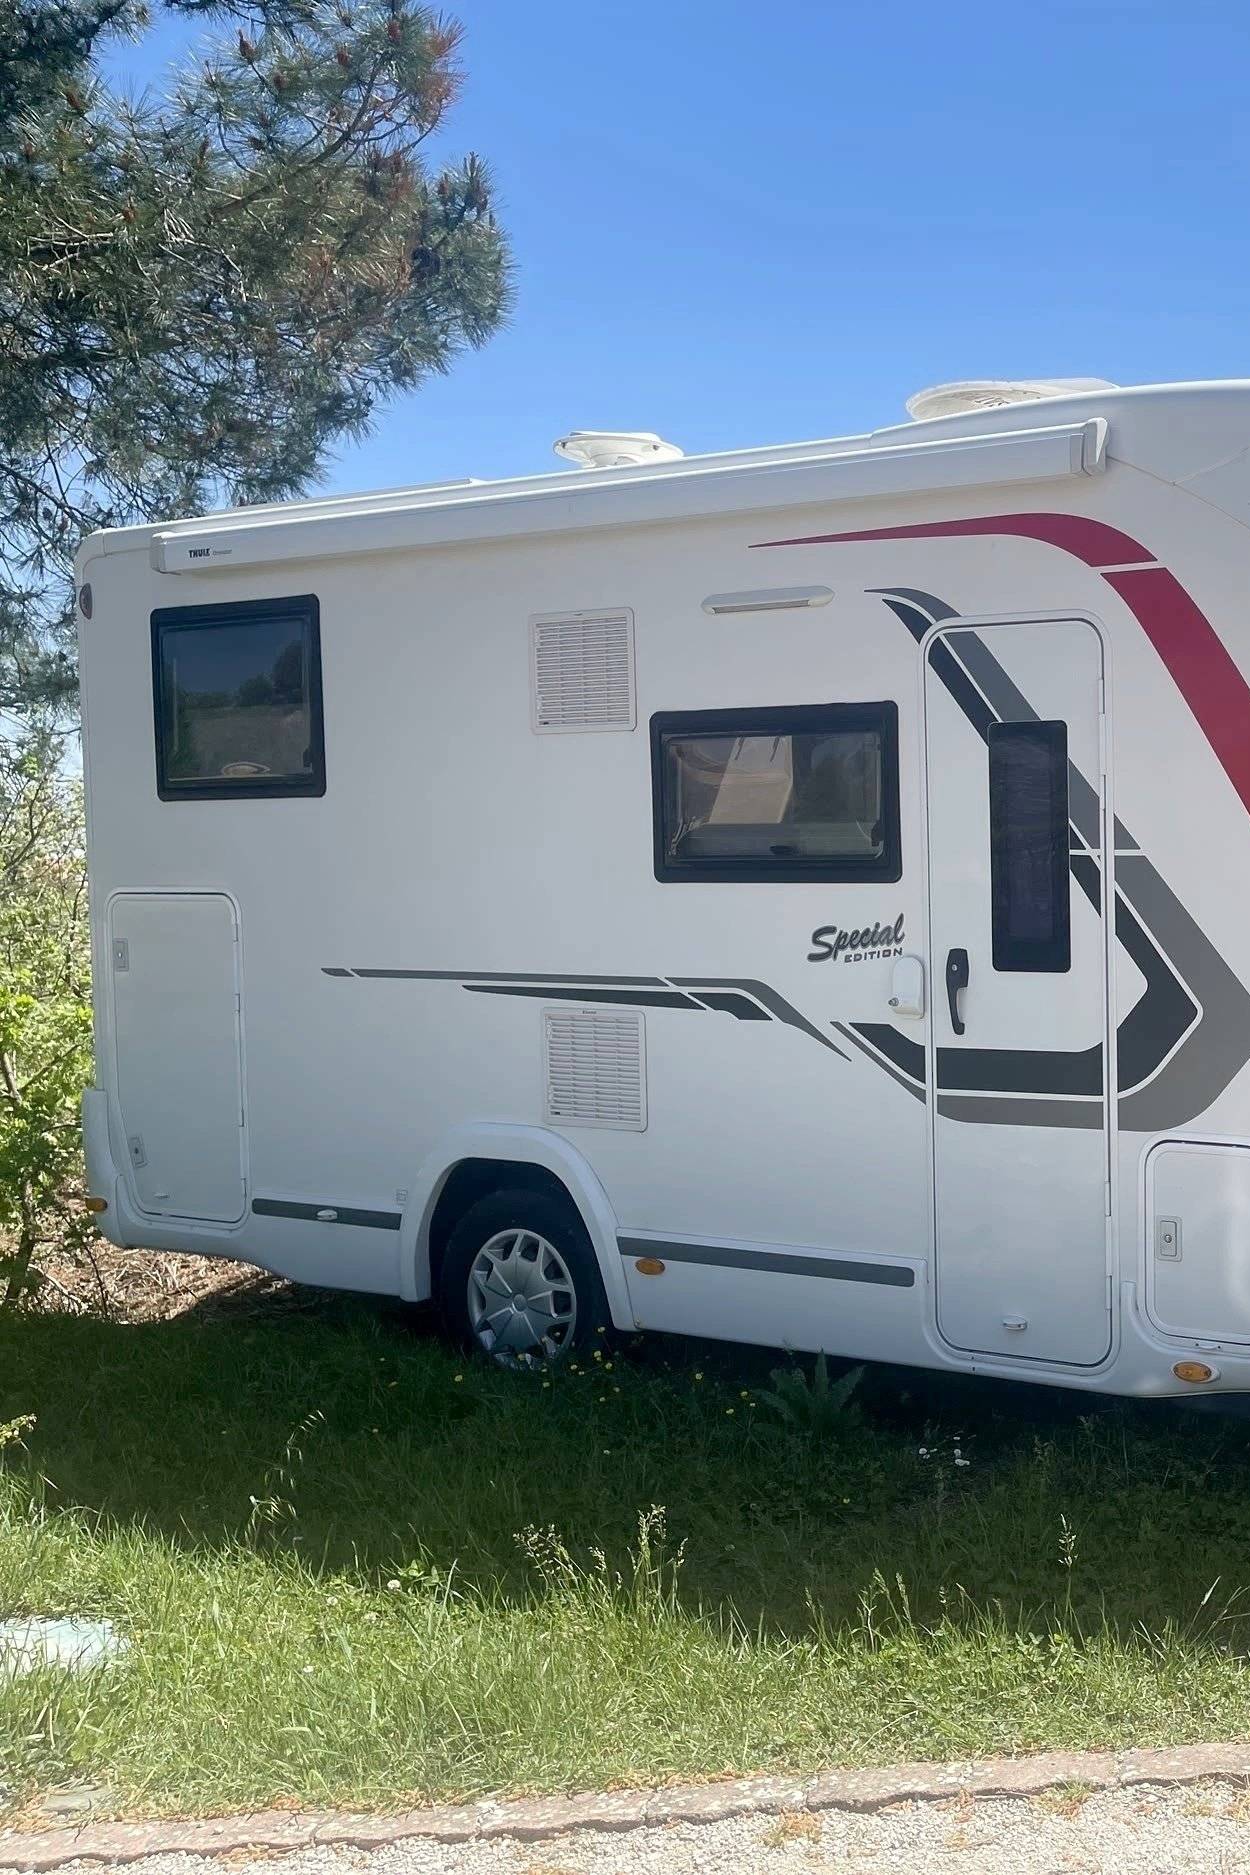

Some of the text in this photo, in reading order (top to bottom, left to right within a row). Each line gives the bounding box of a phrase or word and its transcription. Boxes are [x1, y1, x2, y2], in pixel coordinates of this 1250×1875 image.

[188, 548, 211, 558] THULE
[807, 912, 905, 963] Special
[844, 947, 903, 963] EDITION
